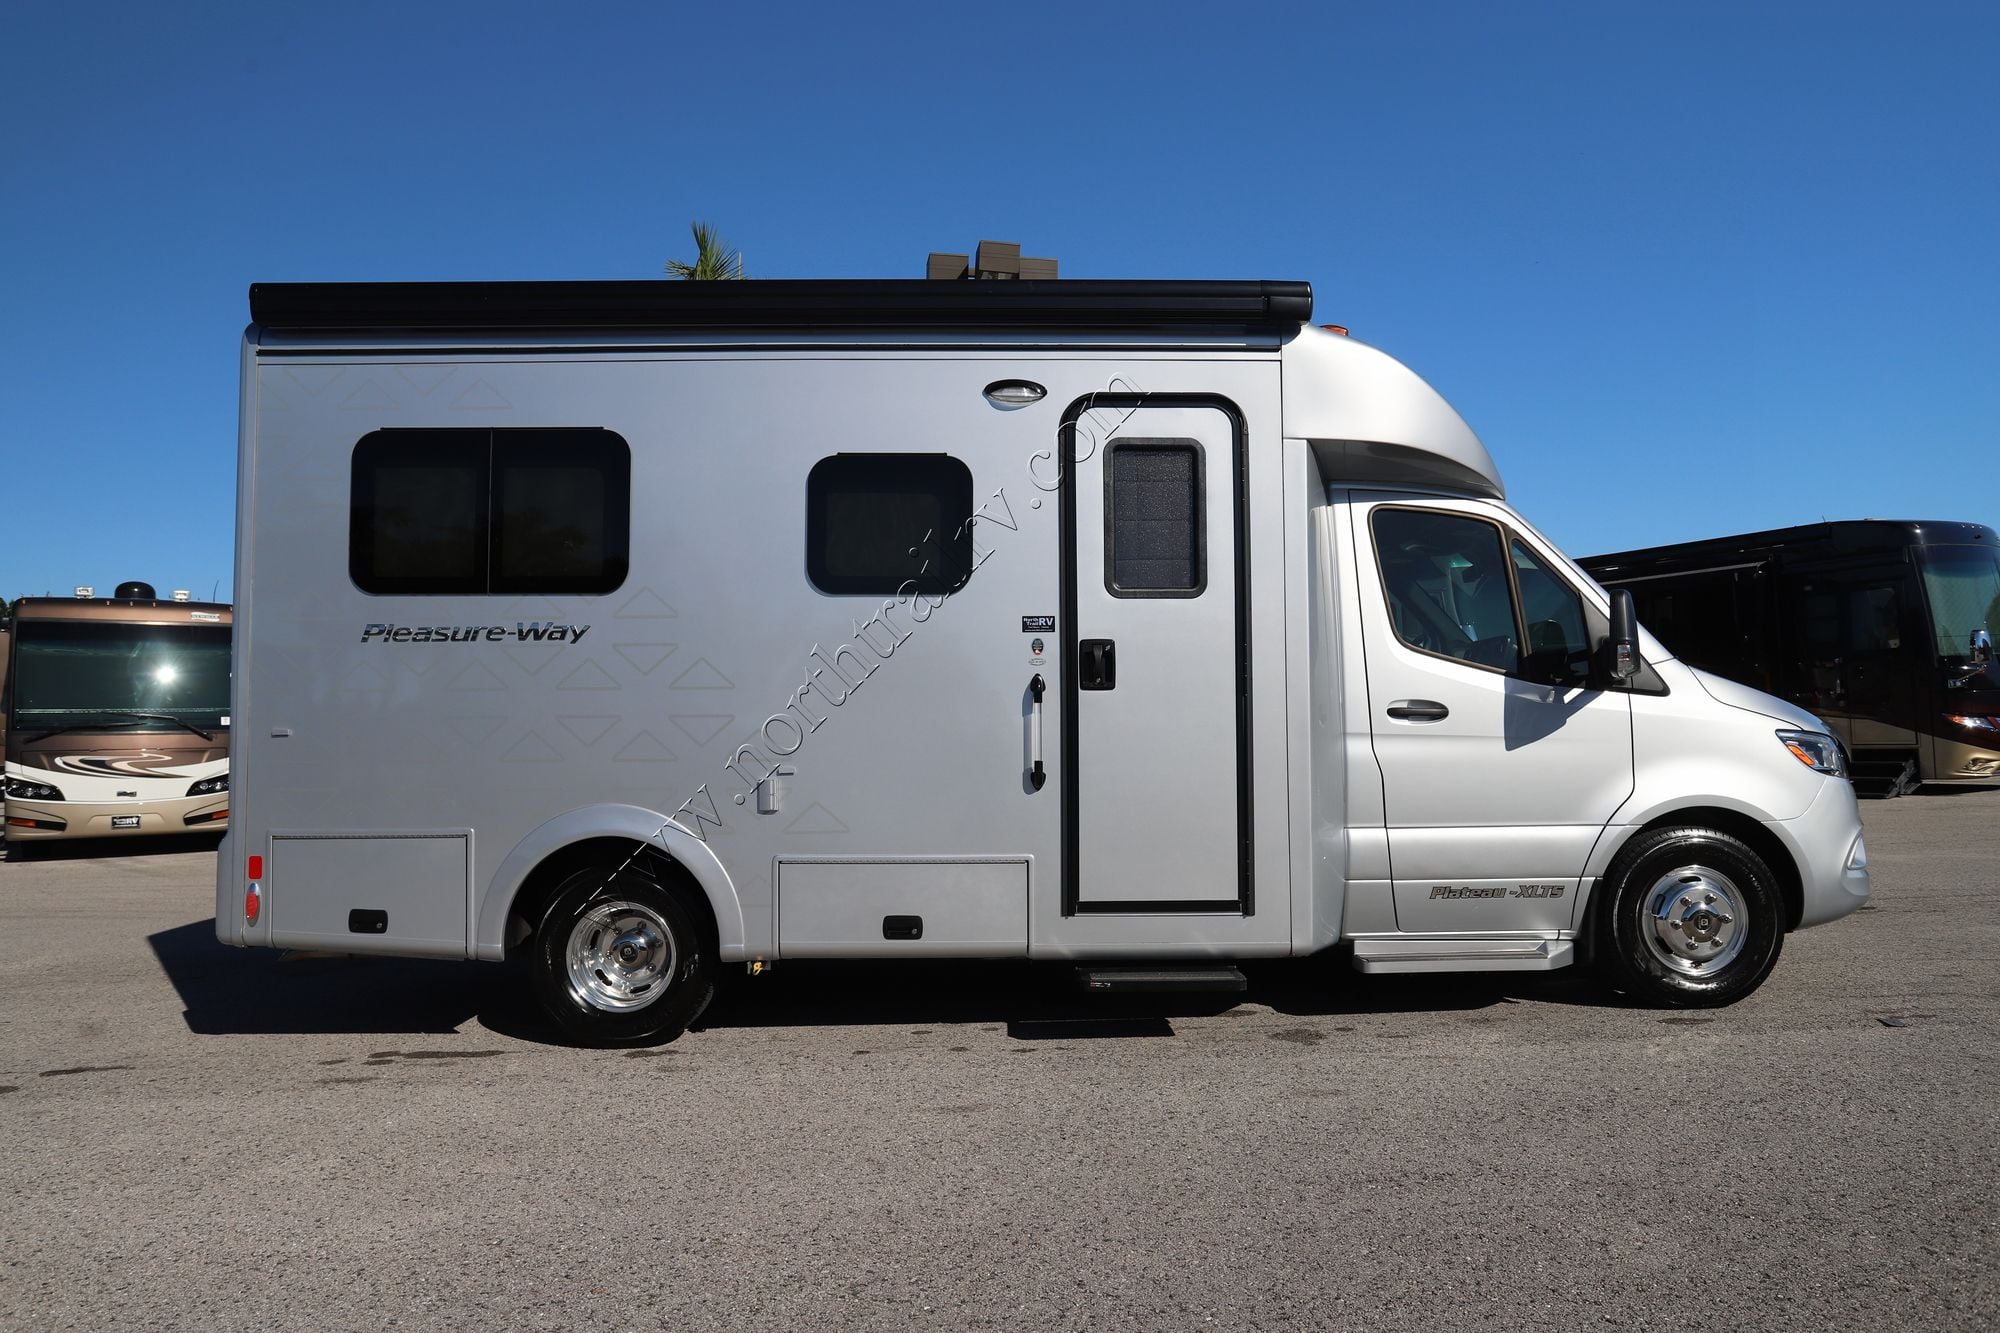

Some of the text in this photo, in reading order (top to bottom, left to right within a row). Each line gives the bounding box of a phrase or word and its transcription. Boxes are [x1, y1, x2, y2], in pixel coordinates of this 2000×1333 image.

[1039, 617, 1054, 626] RV
[360, 621, 591, 645] Pleasure-Way
[1429, 886, 1507, 900] Plateau
